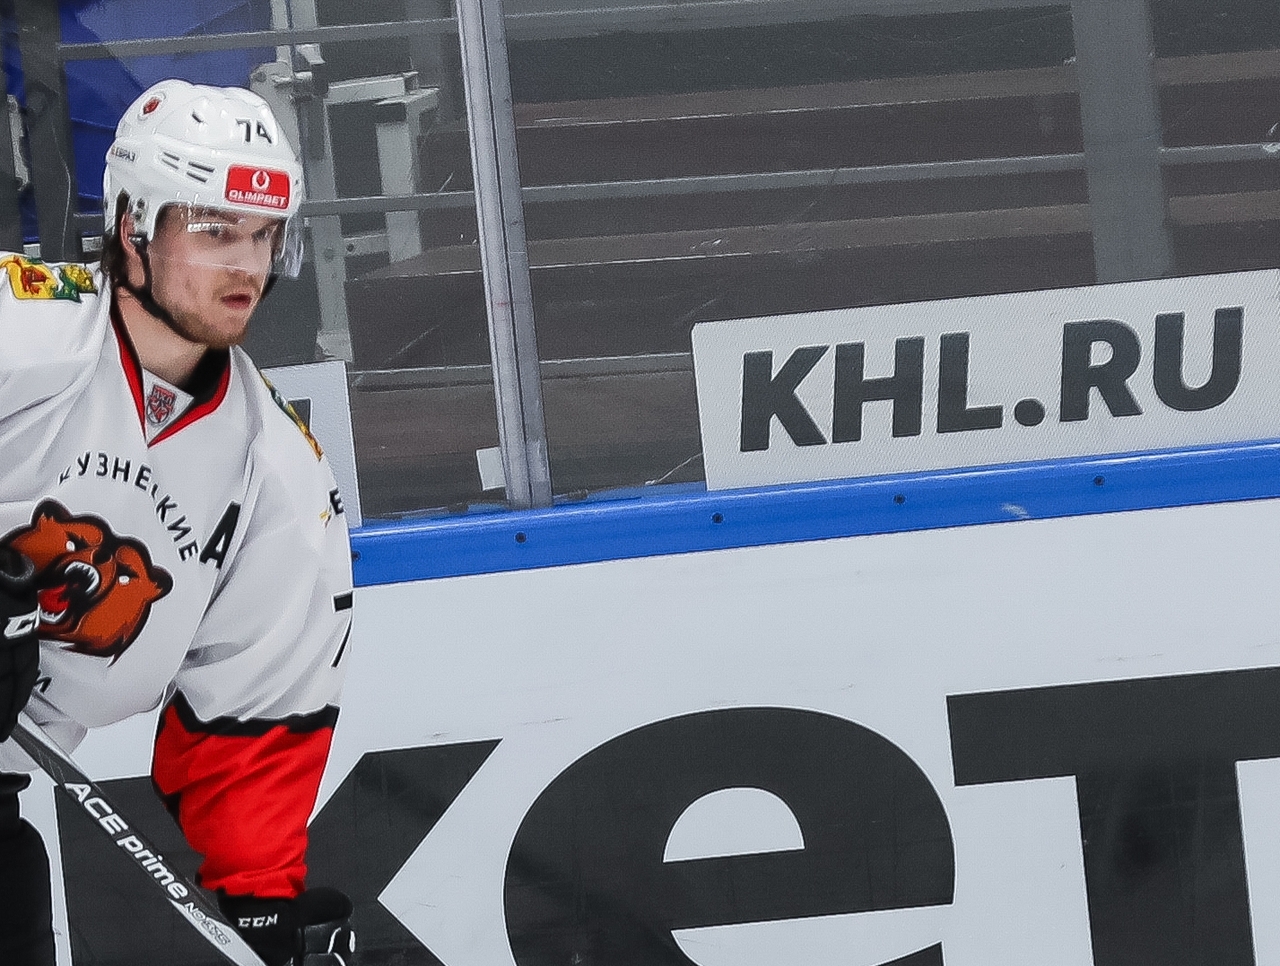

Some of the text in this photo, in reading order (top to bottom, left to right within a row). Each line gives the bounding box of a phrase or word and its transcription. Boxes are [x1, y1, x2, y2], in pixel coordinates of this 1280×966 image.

[235, 118, 273, 145] 74
[228, 190, 287, 207] OLIMPBET
[739, 306, 1245, 453] KHL.RU
[64, 782, 189, 900] ACE prime
[238, 914, 278, 928] CCM
